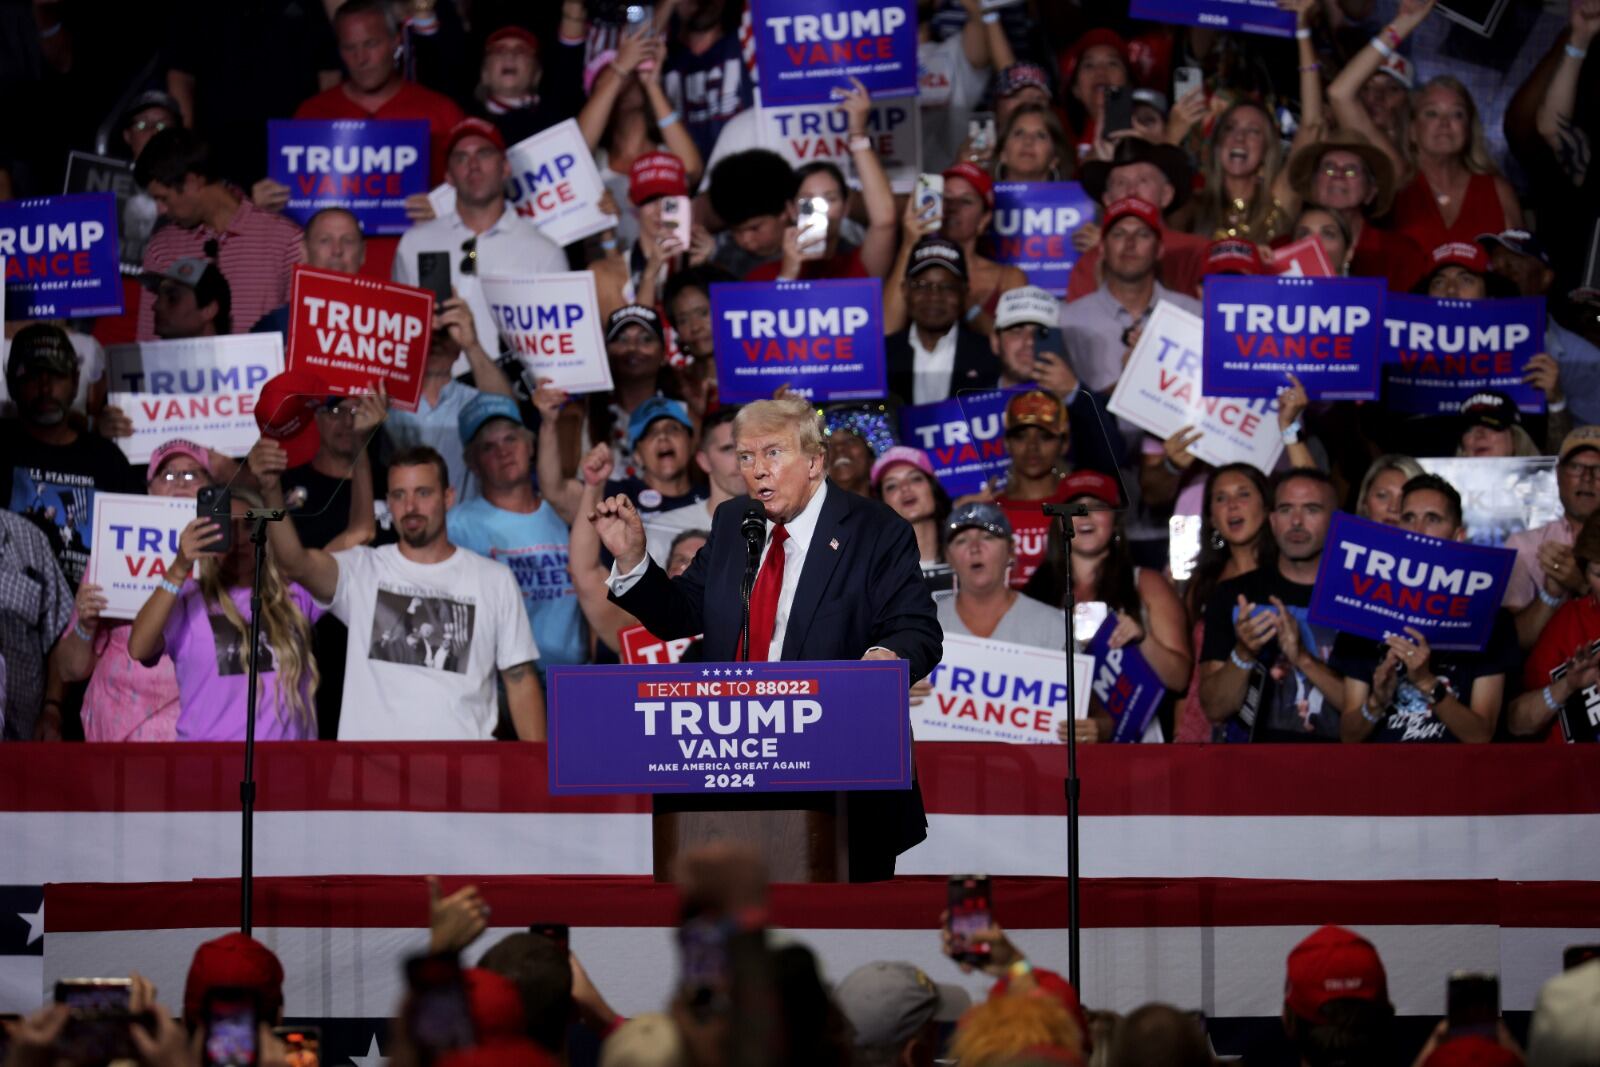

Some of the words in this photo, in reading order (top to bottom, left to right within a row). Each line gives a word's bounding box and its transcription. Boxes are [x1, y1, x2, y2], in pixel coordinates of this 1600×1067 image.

[766, 7, 906, 45] TRUMP
[785, 37, 895, 66] VANCE
[281, 145, 418, 174] TRUMP
[791, 133, 895, 159] VANE
[298, 174, 402, 196] VANCE
[303, 295, 423, 343] TRUMP
[491, 303, 584, 331] TRUMP
[724, 306, 869, 339] TRUMP
[1217, 303, 1371, 335] TRUMP
[316, 327, 409, 369] VANCE
[742, 336, 856, 363] VANCE
[1235, 334, 1354, 360] VANCE
[1383, 318, 1530, 353] TRUMP
[760, 365, 798, 375] AMERICA
[1223, 361, 1250, 370] MAKE
[1252, 361, 1295, 371] AMERICA
[1296, 362, 1326, 372] GREAT
[1399, 350, 1513, 376] VANCE
[121, 365, 269, 397] TRUMP
[141, 394, 255, 422] VANCE
[508, 552, 569, 570] MEAN
[1339, 540, 1494, 597] TRUMP
[112, 581, 138, 591] MAKE
[1352, 571, 1471, 618] VANCE
[1334, 594, 1362, 609] MAKE
[1363, 602, 1405, 621] AMERICA
[1406, 615, 1438, 627] GREAT
[646, 682, 691, 697] TEXT
[696, 682, 722, 696] NC
[726, 681, 750, 696] TO
[755, 681, 810, 695] 88022
[929, 663, 1068, 708] TRUMP
[634, 699, 823, 736] TRUMP
[937, 693, 1053, 733] VANCE
[678, 737, 778, 759] VANCE
[648, 763, 679, 772] MAKE
[682, 762, 731, 772] AMERICA
[734, 761, 769, 771] GREAT
[772, 760, 811, 770] AGAIN!
[704, 773, 755, 788] 2024
